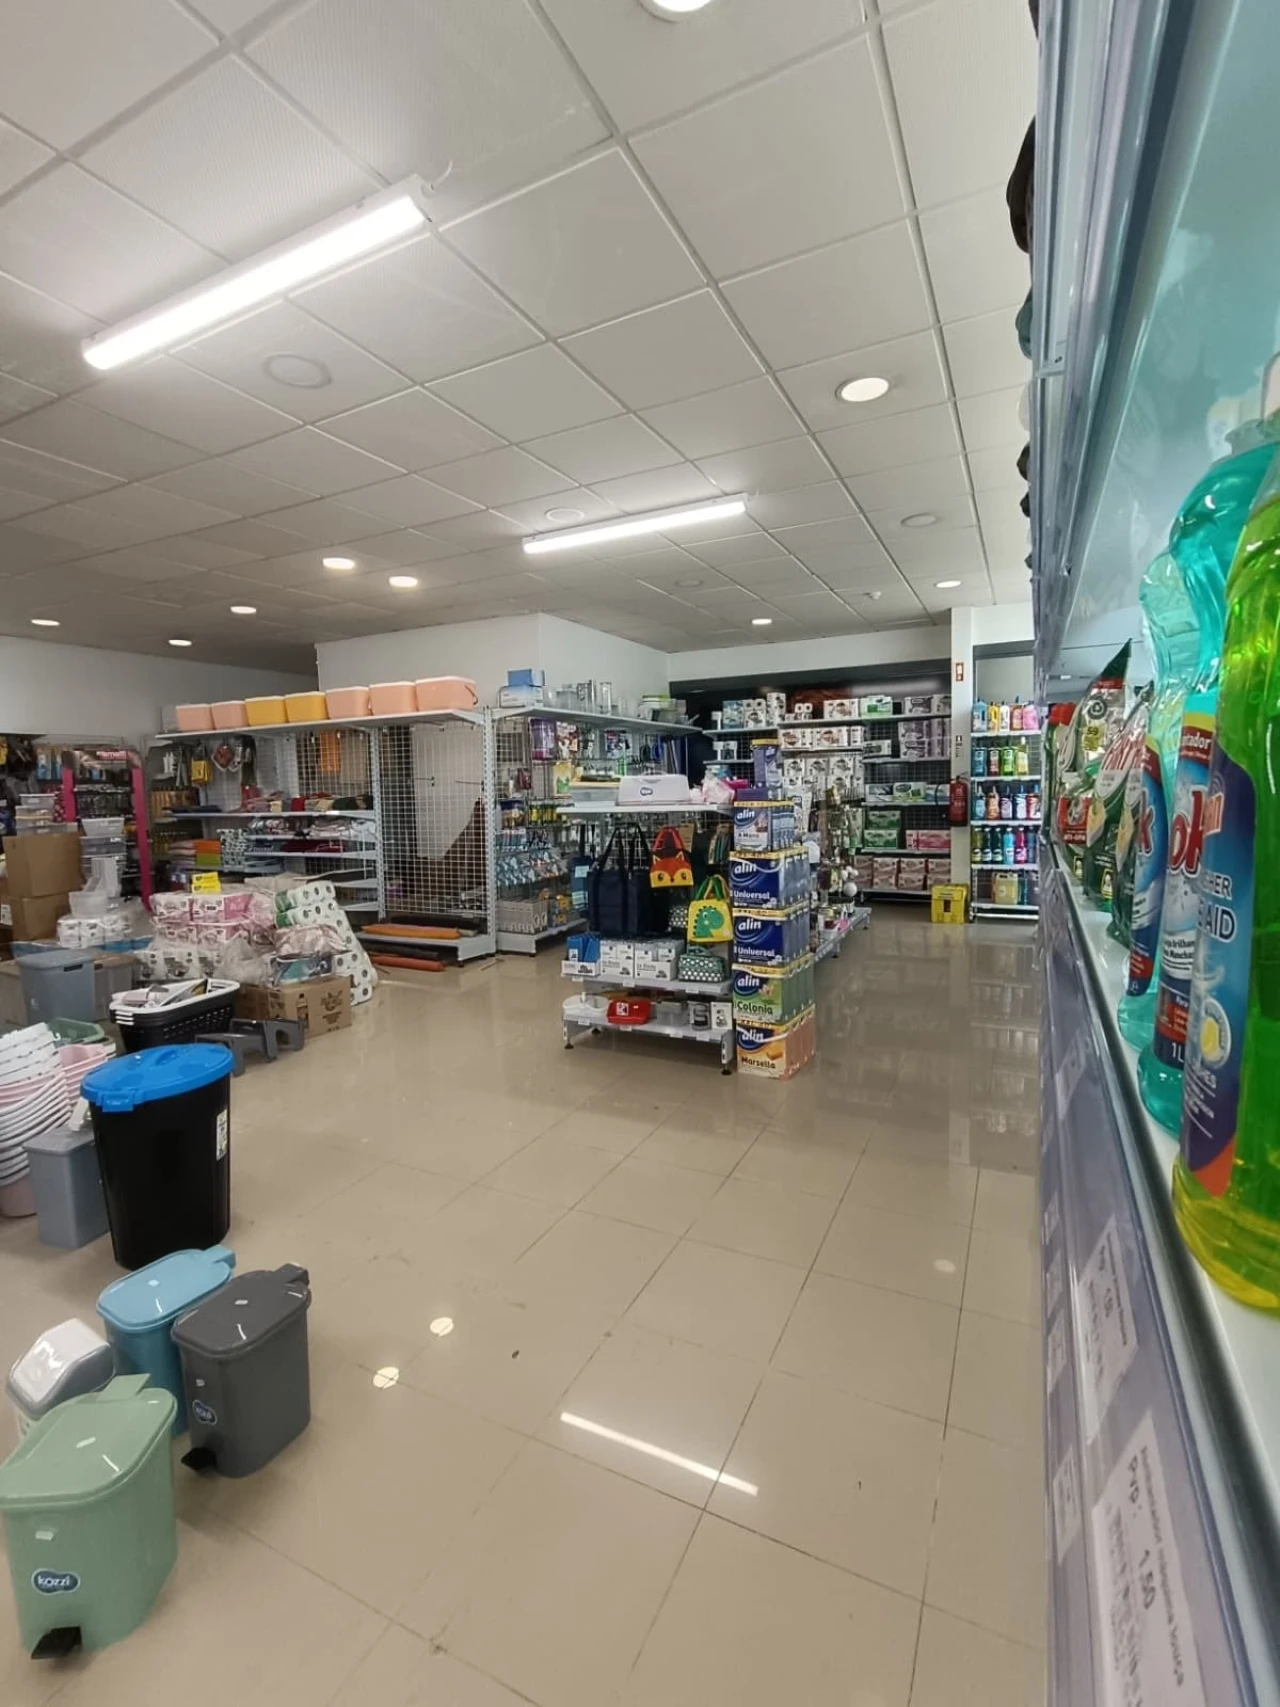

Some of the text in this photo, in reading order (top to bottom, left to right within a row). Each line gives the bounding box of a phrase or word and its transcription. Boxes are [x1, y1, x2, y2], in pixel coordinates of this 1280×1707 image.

[736, 808, 756, 820] alin
[734, 863, 757, 875] alin
[734, 890, 771, 902] Universal
[738, 918, 762, 931] alin
[738, 946, 776, 957] Universal
[737, 974, 760, 987] alin
[737, 1001, 774, 1015] Colonia
[741, 1029, 764, 1041] alin
[741, 1056, 776, 1069] Marsella
[38, 1575, 70, 1586] kozzi
